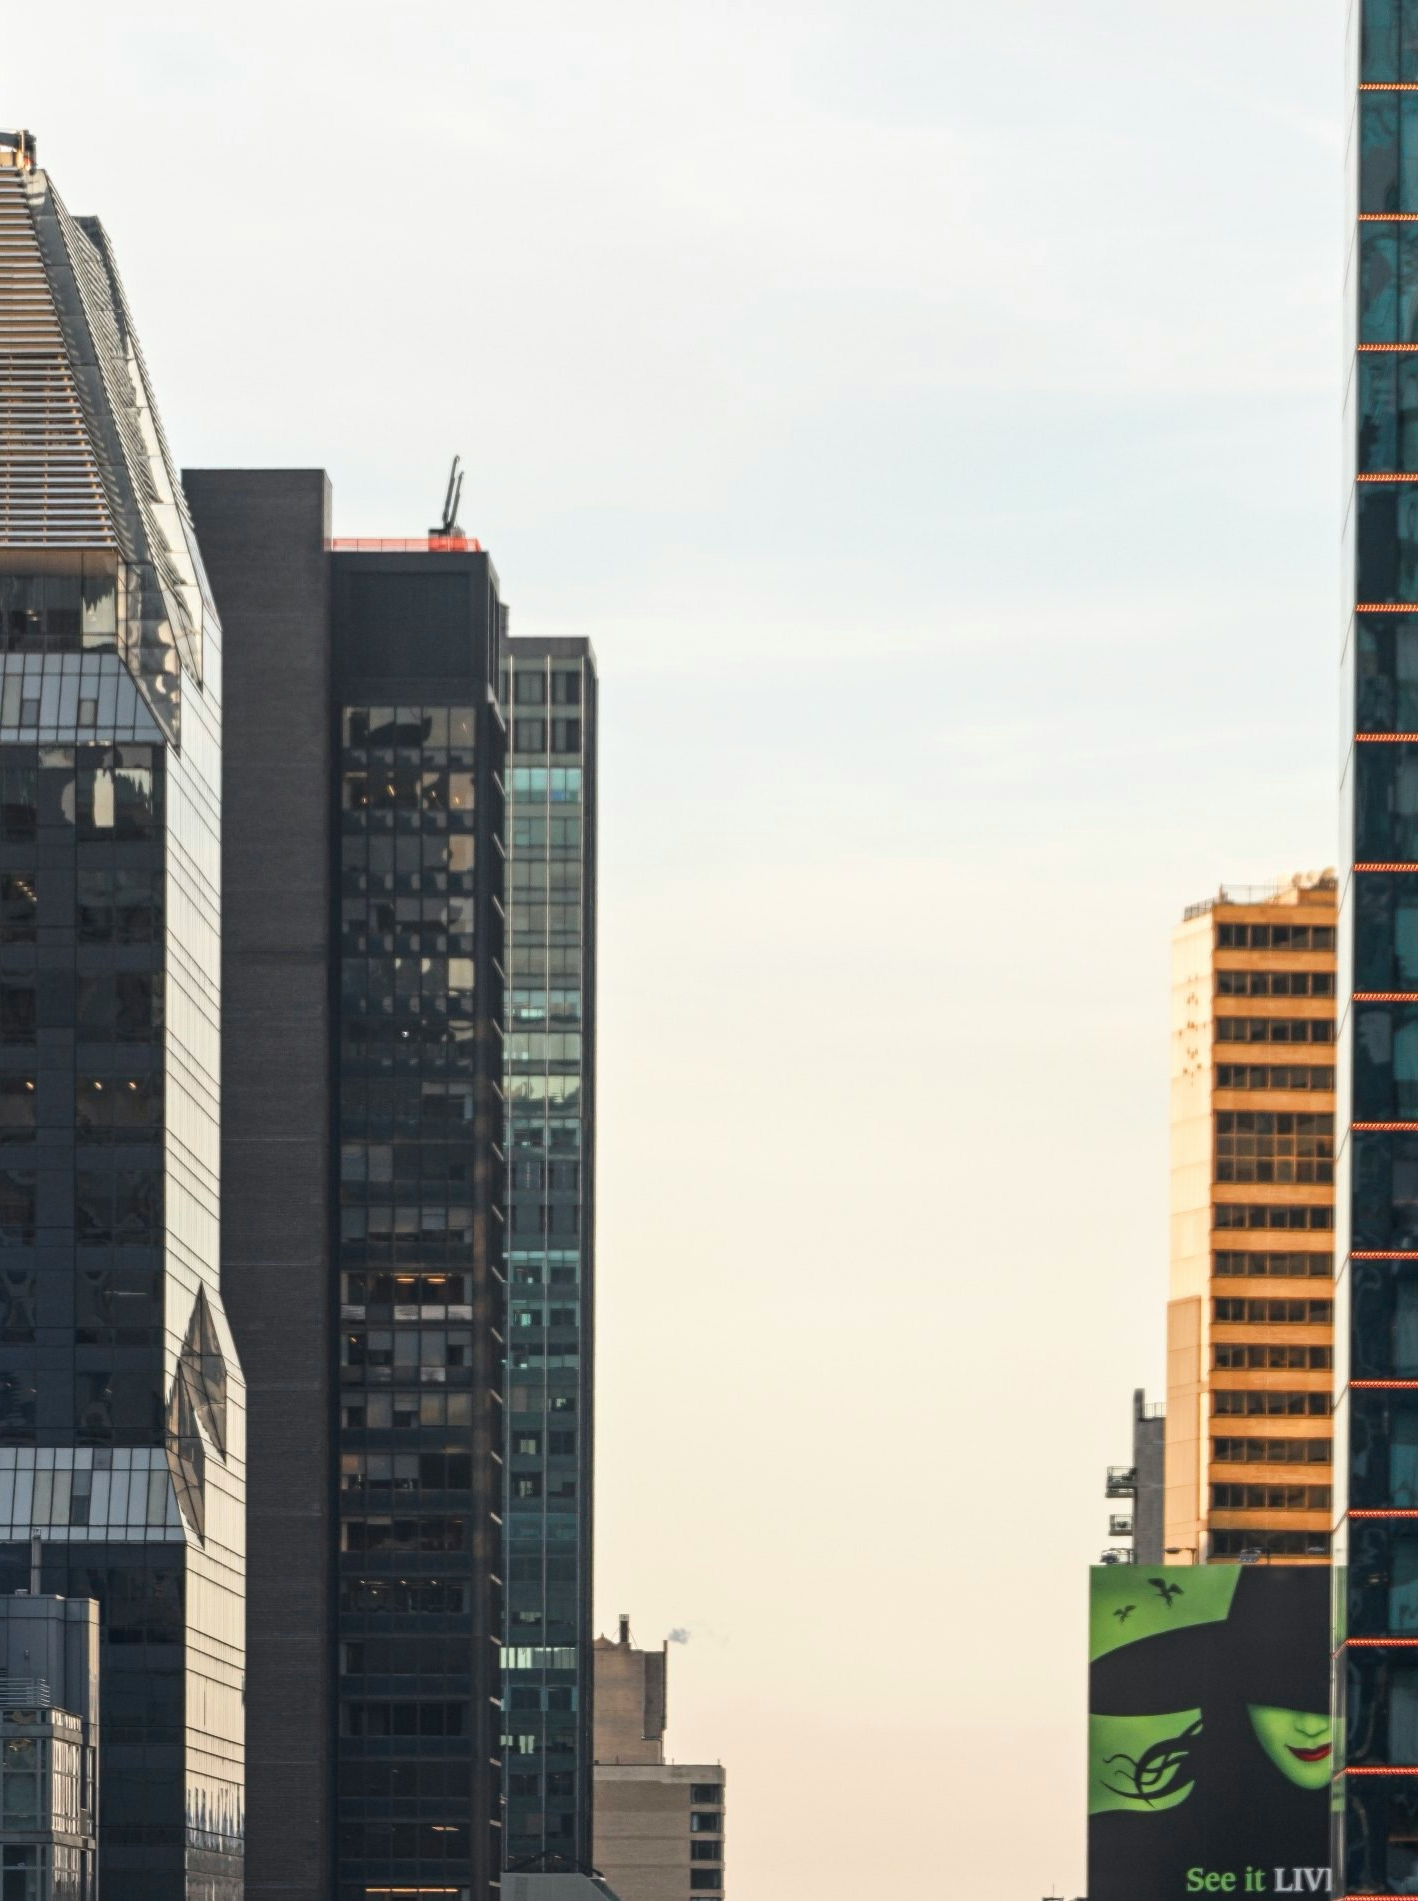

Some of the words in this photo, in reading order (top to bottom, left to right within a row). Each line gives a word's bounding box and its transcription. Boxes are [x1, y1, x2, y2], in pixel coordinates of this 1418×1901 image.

[1187, 1868, 1236, 1894] See
[1244, 1868, 1265, 1893] it
[1275, 1868, 1332, 1892] LIV
